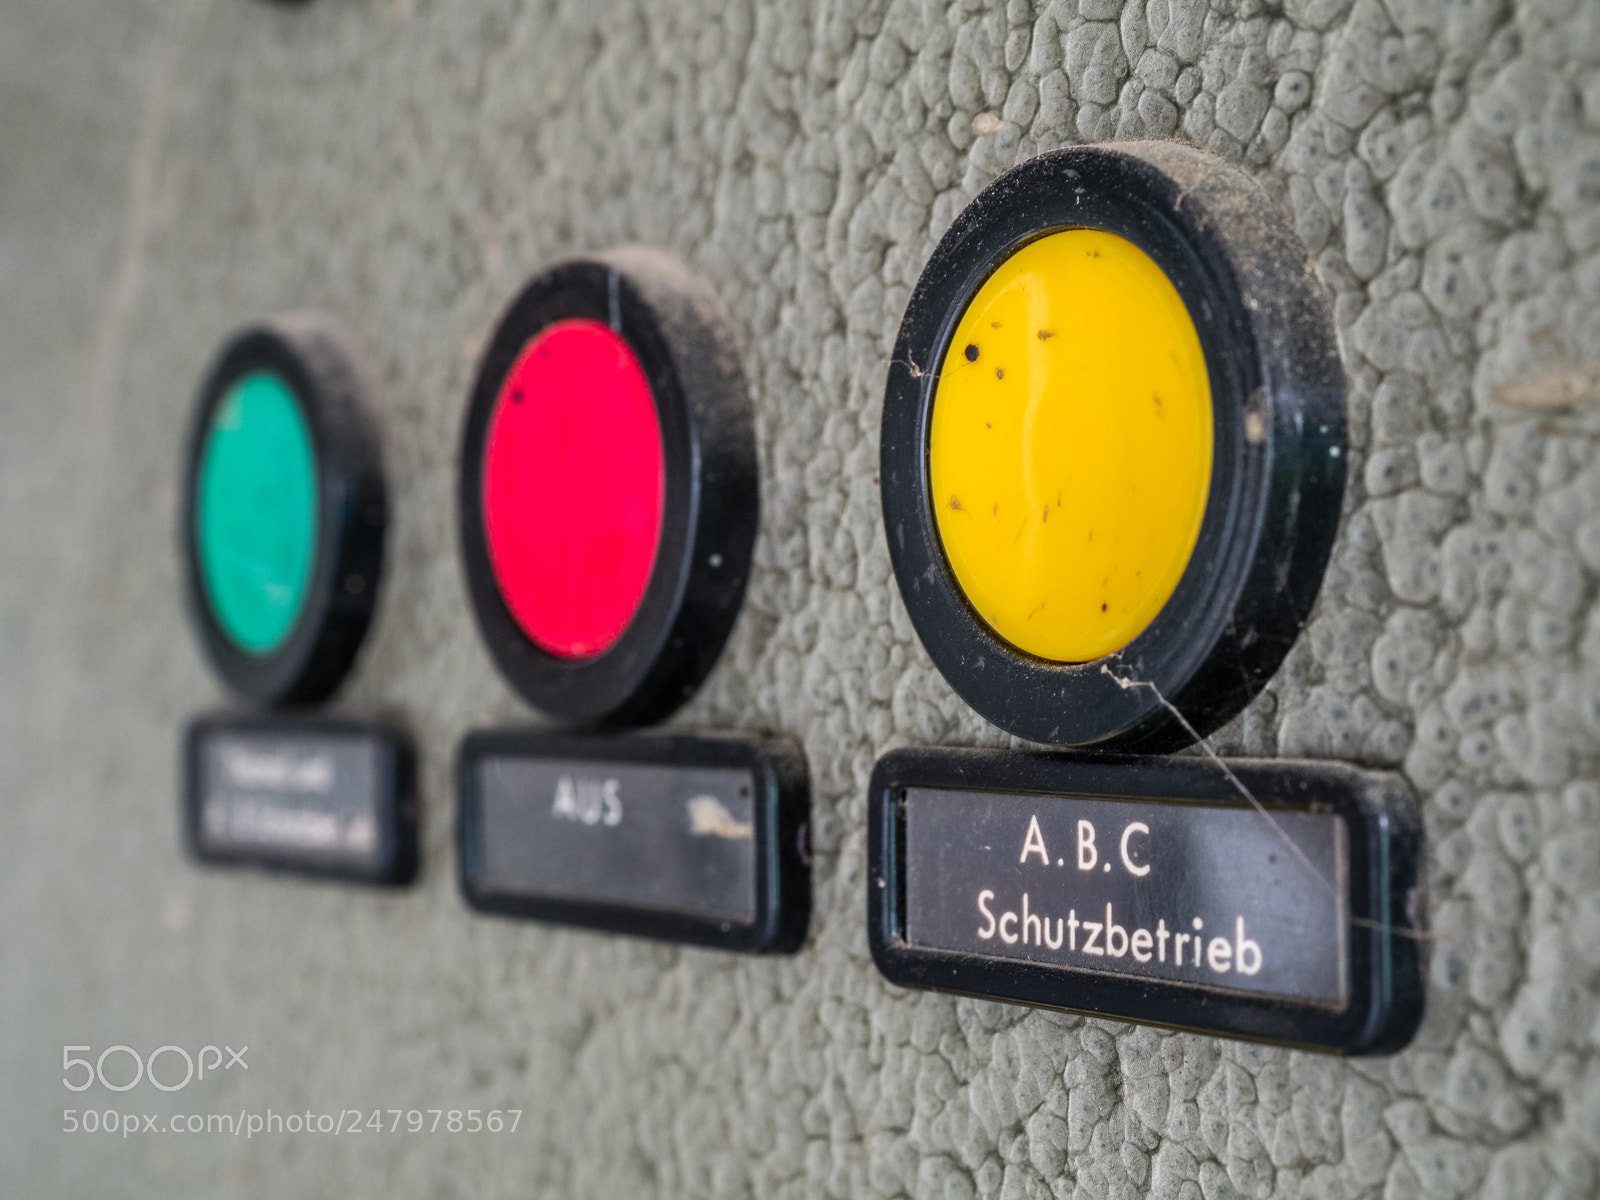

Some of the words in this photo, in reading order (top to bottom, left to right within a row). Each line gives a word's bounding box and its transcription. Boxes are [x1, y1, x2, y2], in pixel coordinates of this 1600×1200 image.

[552, 776, 624, 826] AUS
[1020, 814, 1151, 877] A.B.C
[976, 889, 1263, 976] Schutzbetrieb
